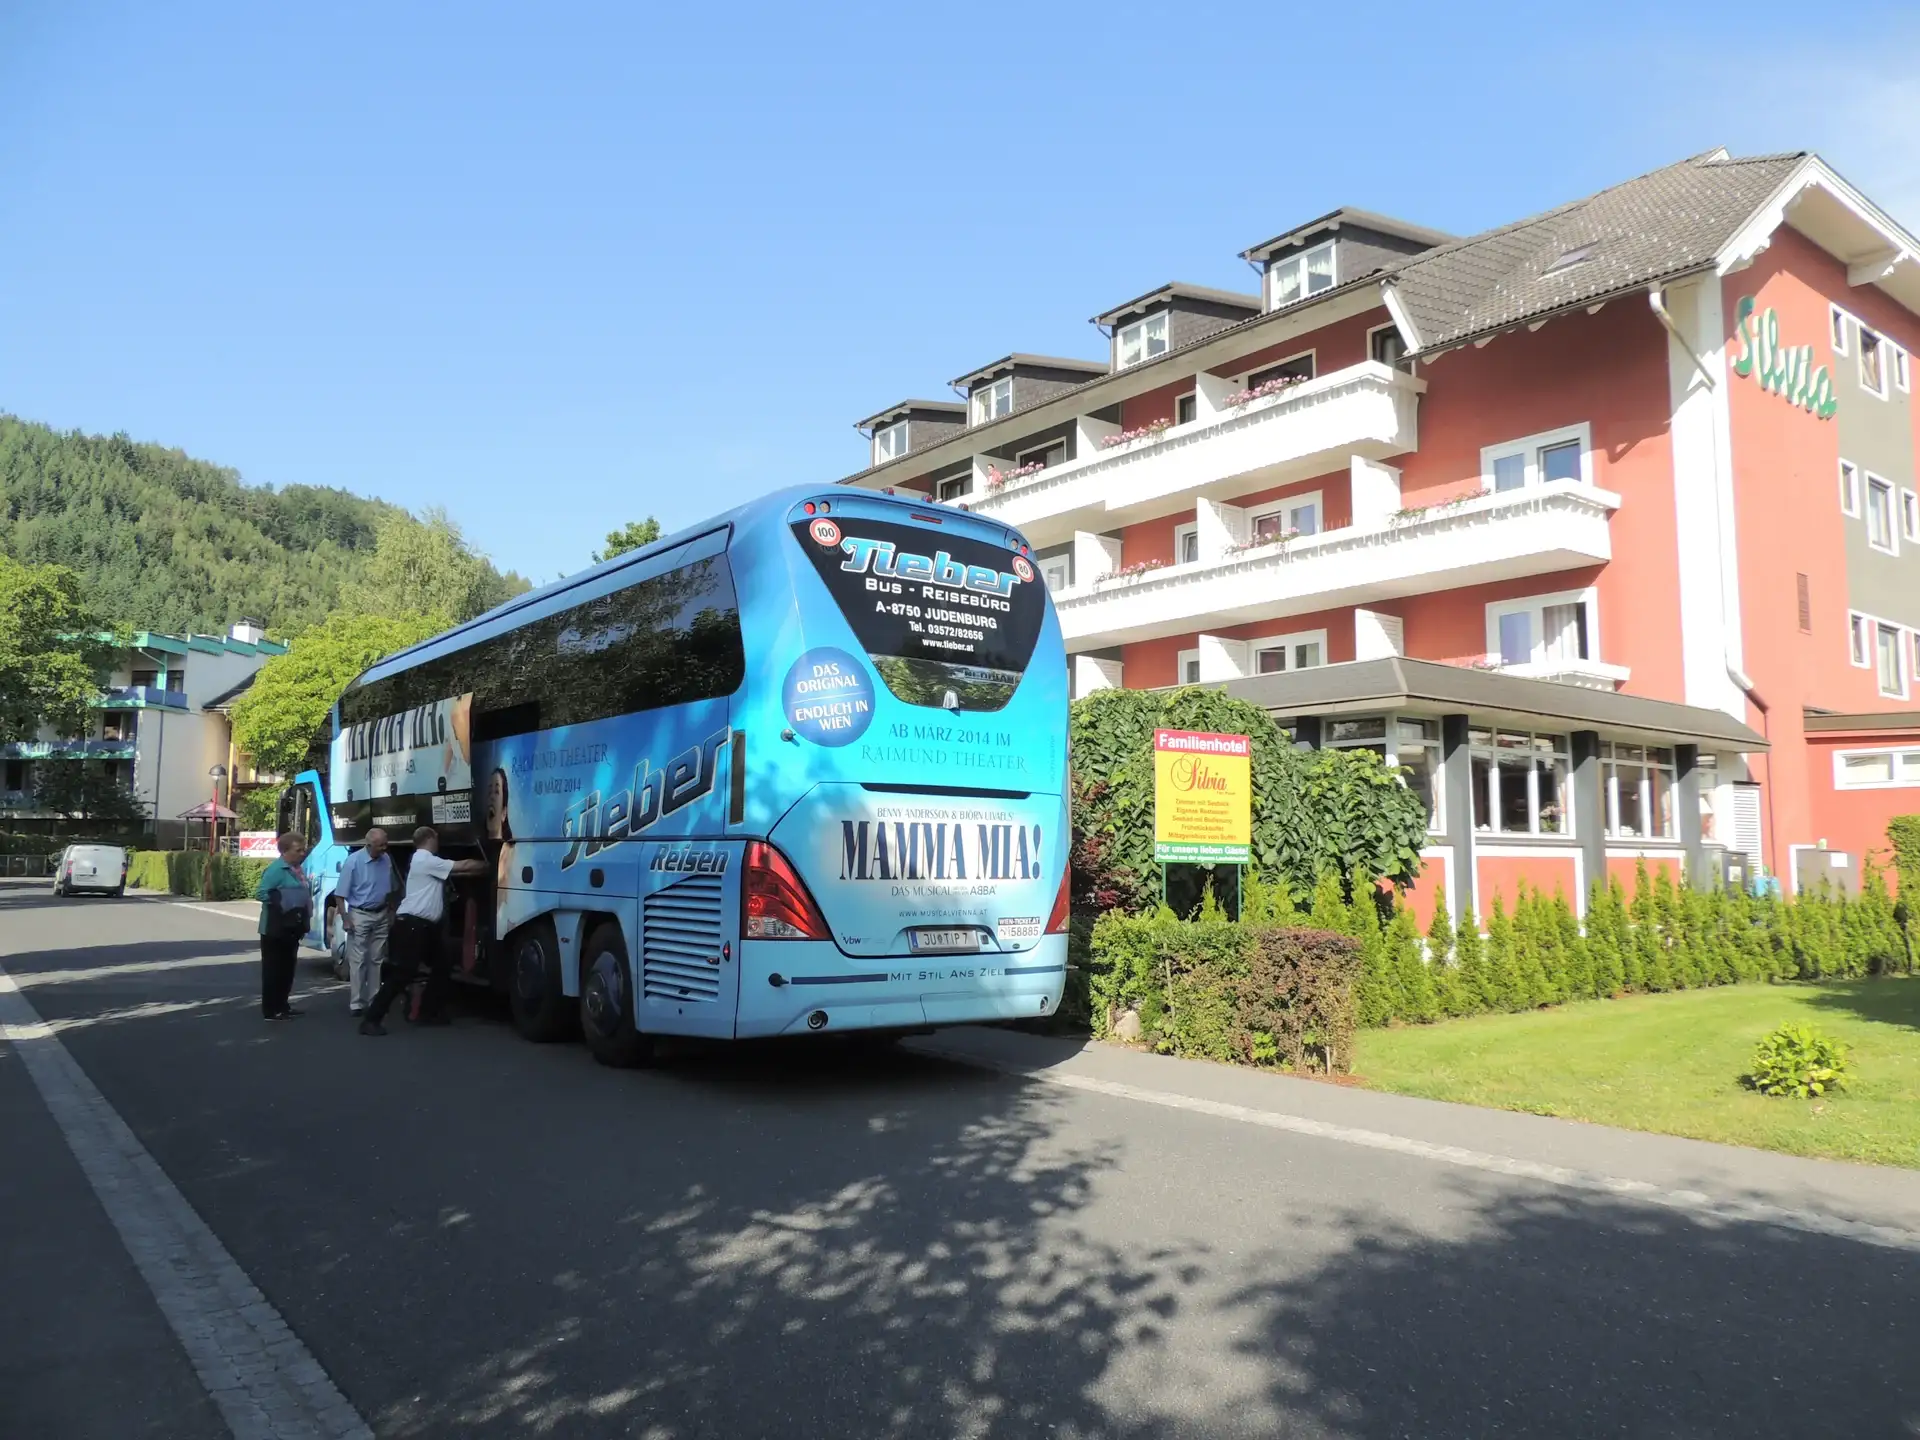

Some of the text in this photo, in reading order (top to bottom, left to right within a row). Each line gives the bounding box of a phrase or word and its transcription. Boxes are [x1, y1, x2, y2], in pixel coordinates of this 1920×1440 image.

[1730, 296, 1838, 420] Silvia
[817, 526, 835, 538] 100
[840, 536, 1021, 598] Tieber
[1018, 563, 1029, 576] 80
[875, 602, 998, 629] A-8750 JUDENBURG
[909, 620, 984, 641] Tel. 03572/82656
[922, 638, 975, 653] www.tieber.at
[812, 663, 840, 678] DAS
[796, 674, 860, 693] ORIGINAL
[795, 699, 869, 722] ENDLICH IN
[819, 715, 852, 731] WIEN
[889, 723, 1012, 747] AB MÄRZ 2014 IM
[1159, 733, 1247, 753] Familienhotel
[559, 743, 613, 768] THEATER
[861, 744, 948, 765] RAIMUND
[952, 750, 1028, 773] THEATER
[1170, 753, 1228, 792] Silvia
[563, 777, 582, 793] 2014
[561, 725, 733, 871] Tieber
[877, 807, 903, 819] BENNY
[904, 808, 950, 820] ANDERSSON
[951, 810, 957, 820] &
[959, 809, 984, 821] BJÖRN
[650, 841, 732, 874] Reisen
[839, 820, 1042, 880] MAMMA MIA!
[1156, 843, 1171, 853] Für
[891, 885, 911, 897] DAS
[913, 885, 952, 896] MUSICAL
[923, 933, 937, 946] JU
[944, 932, 960, 944] TIP
[1010, 926, 1039, 937] 58885
